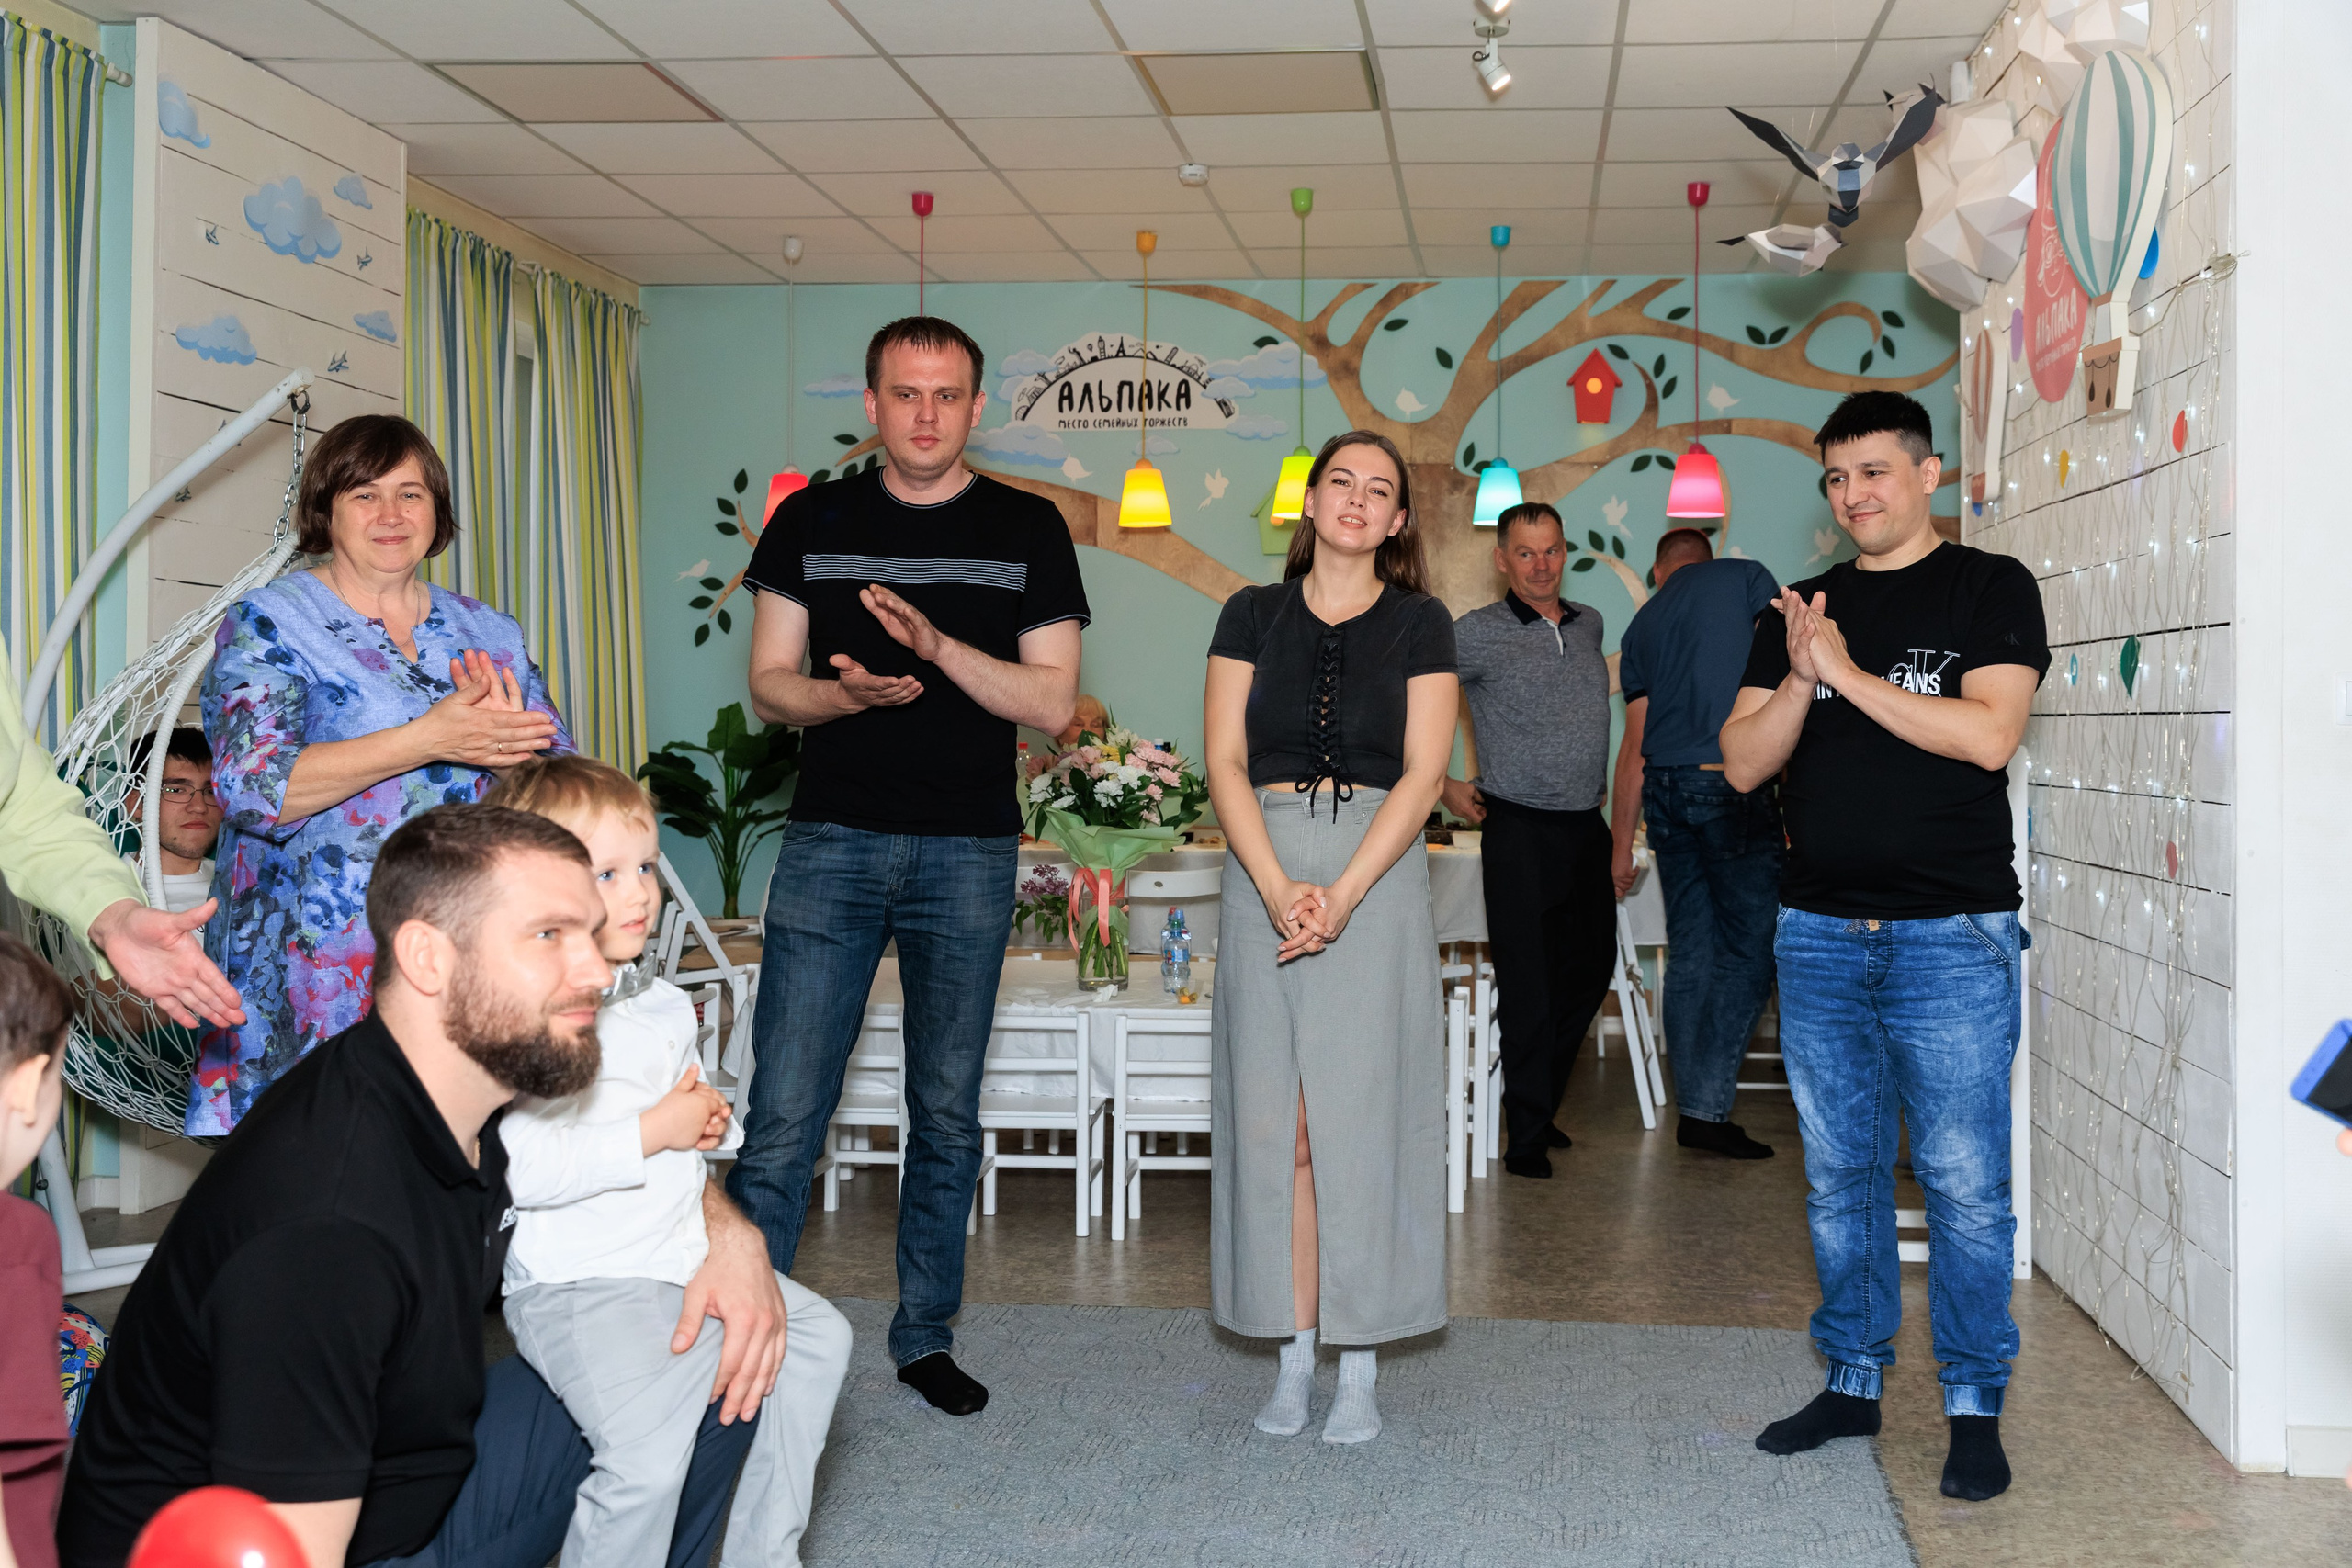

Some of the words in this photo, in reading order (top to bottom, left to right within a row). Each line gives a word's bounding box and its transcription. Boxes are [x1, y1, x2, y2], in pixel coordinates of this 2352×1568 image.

[2035, 288, 2077, 355] АЛЬПАКА
[1057, 378, 1192, 413] АЛЬПАКА
[1058, 418, 1089, 429] МЕСТО
[1092, 417, 1139, 429] СЕМЕЙНЫХ
[1142, 416, 1189, 428] ТОРЖЕСТВ
